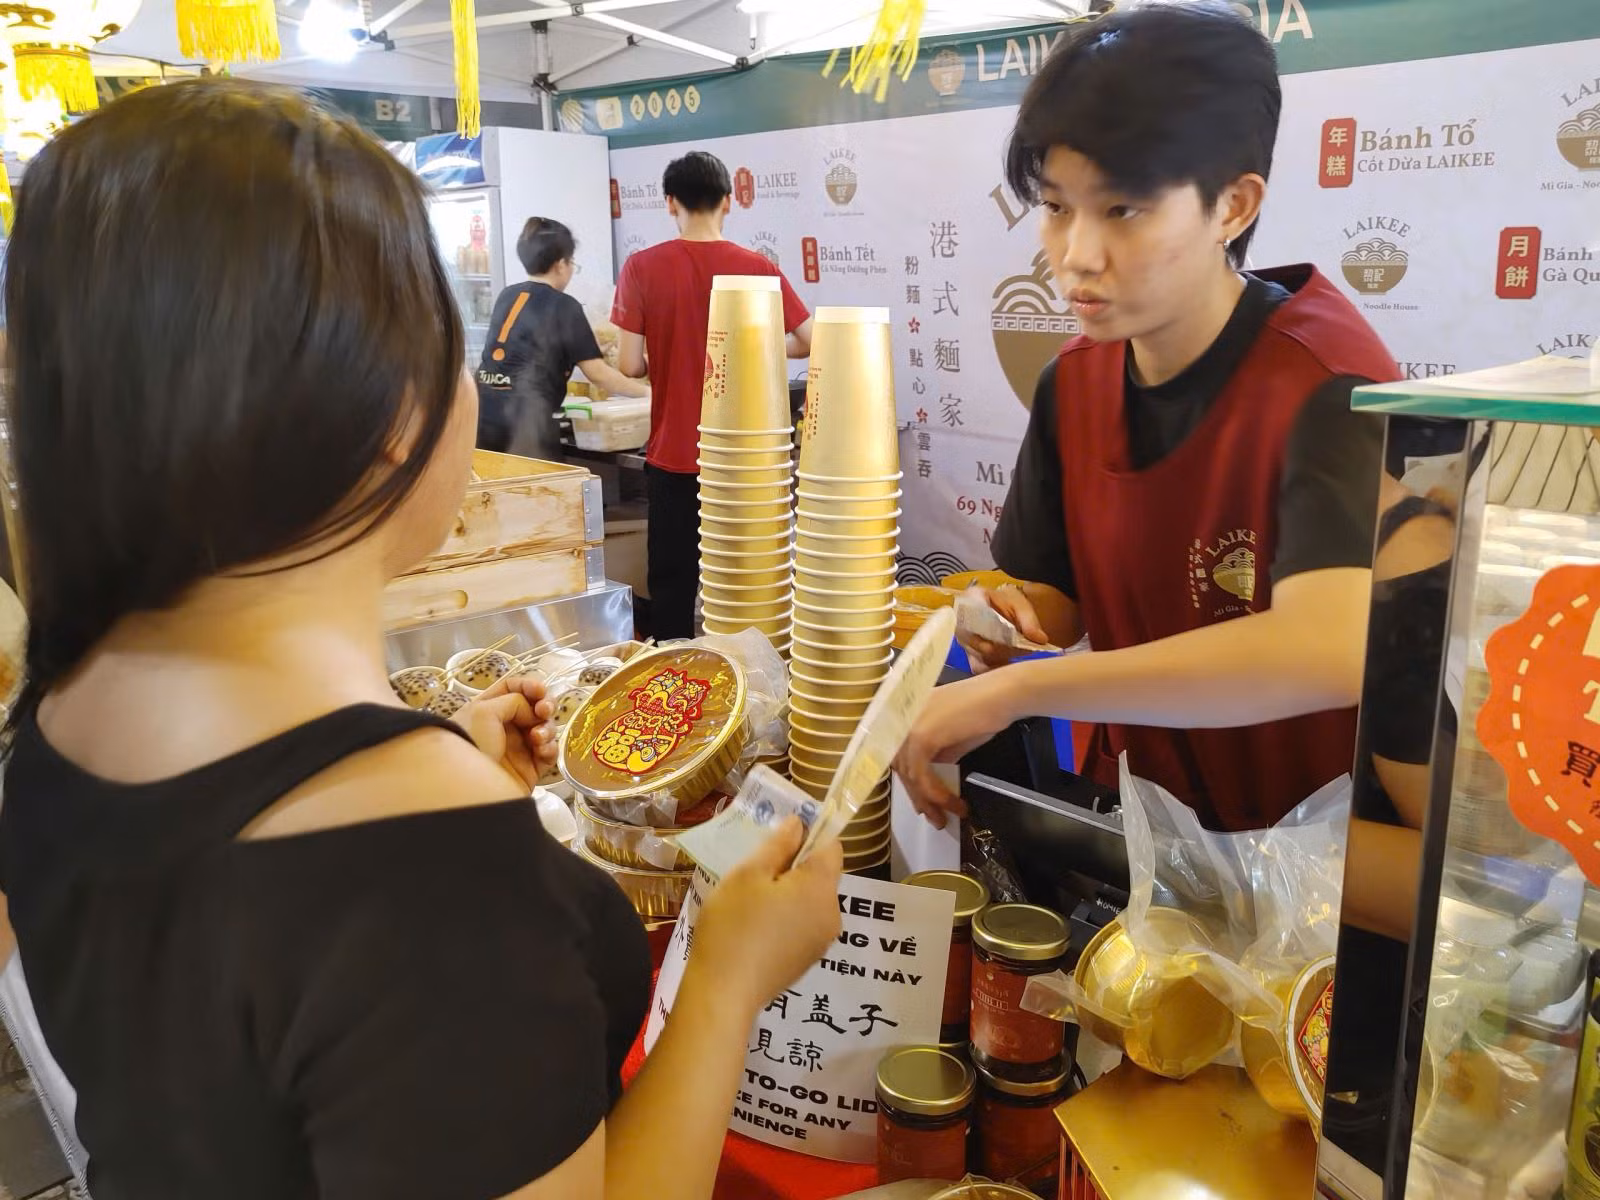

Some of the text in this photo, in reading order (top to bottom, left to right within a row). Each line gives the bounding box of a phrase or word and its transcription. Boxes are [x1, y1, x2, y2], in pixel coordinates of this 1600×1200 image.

[375, 99, 412, 122] B2
[1359, 119, 1476, 152] Bánh Tổ
[1326, 126, 1348, 176] 年糕
[1357, 152, 1496, 173] Cốt Dừa LAIKEE
[757, 172, 798, 188] LAIKEE
[1343, 216, 1411, 240] LAIKEE
[1505, 235, 1529, 288] 月餅
[1543, 247, 1592, 261] Bánh
[1543, 267, 1600, 285] Gà Qu
[929, 221, 965, 427] 港式麵家
[976, 461, 1006, 486] Mì
[957, 496, 976, 515] 69
[879, 936, 917, 956] VỀ
[820, 958, 923, 986] TIỆN NÀY
[744, 1068, 829, 1105] TO-GO
[758, 1098, 798, 1120] FOR
[804, 1112, 852, 1131] ANY
